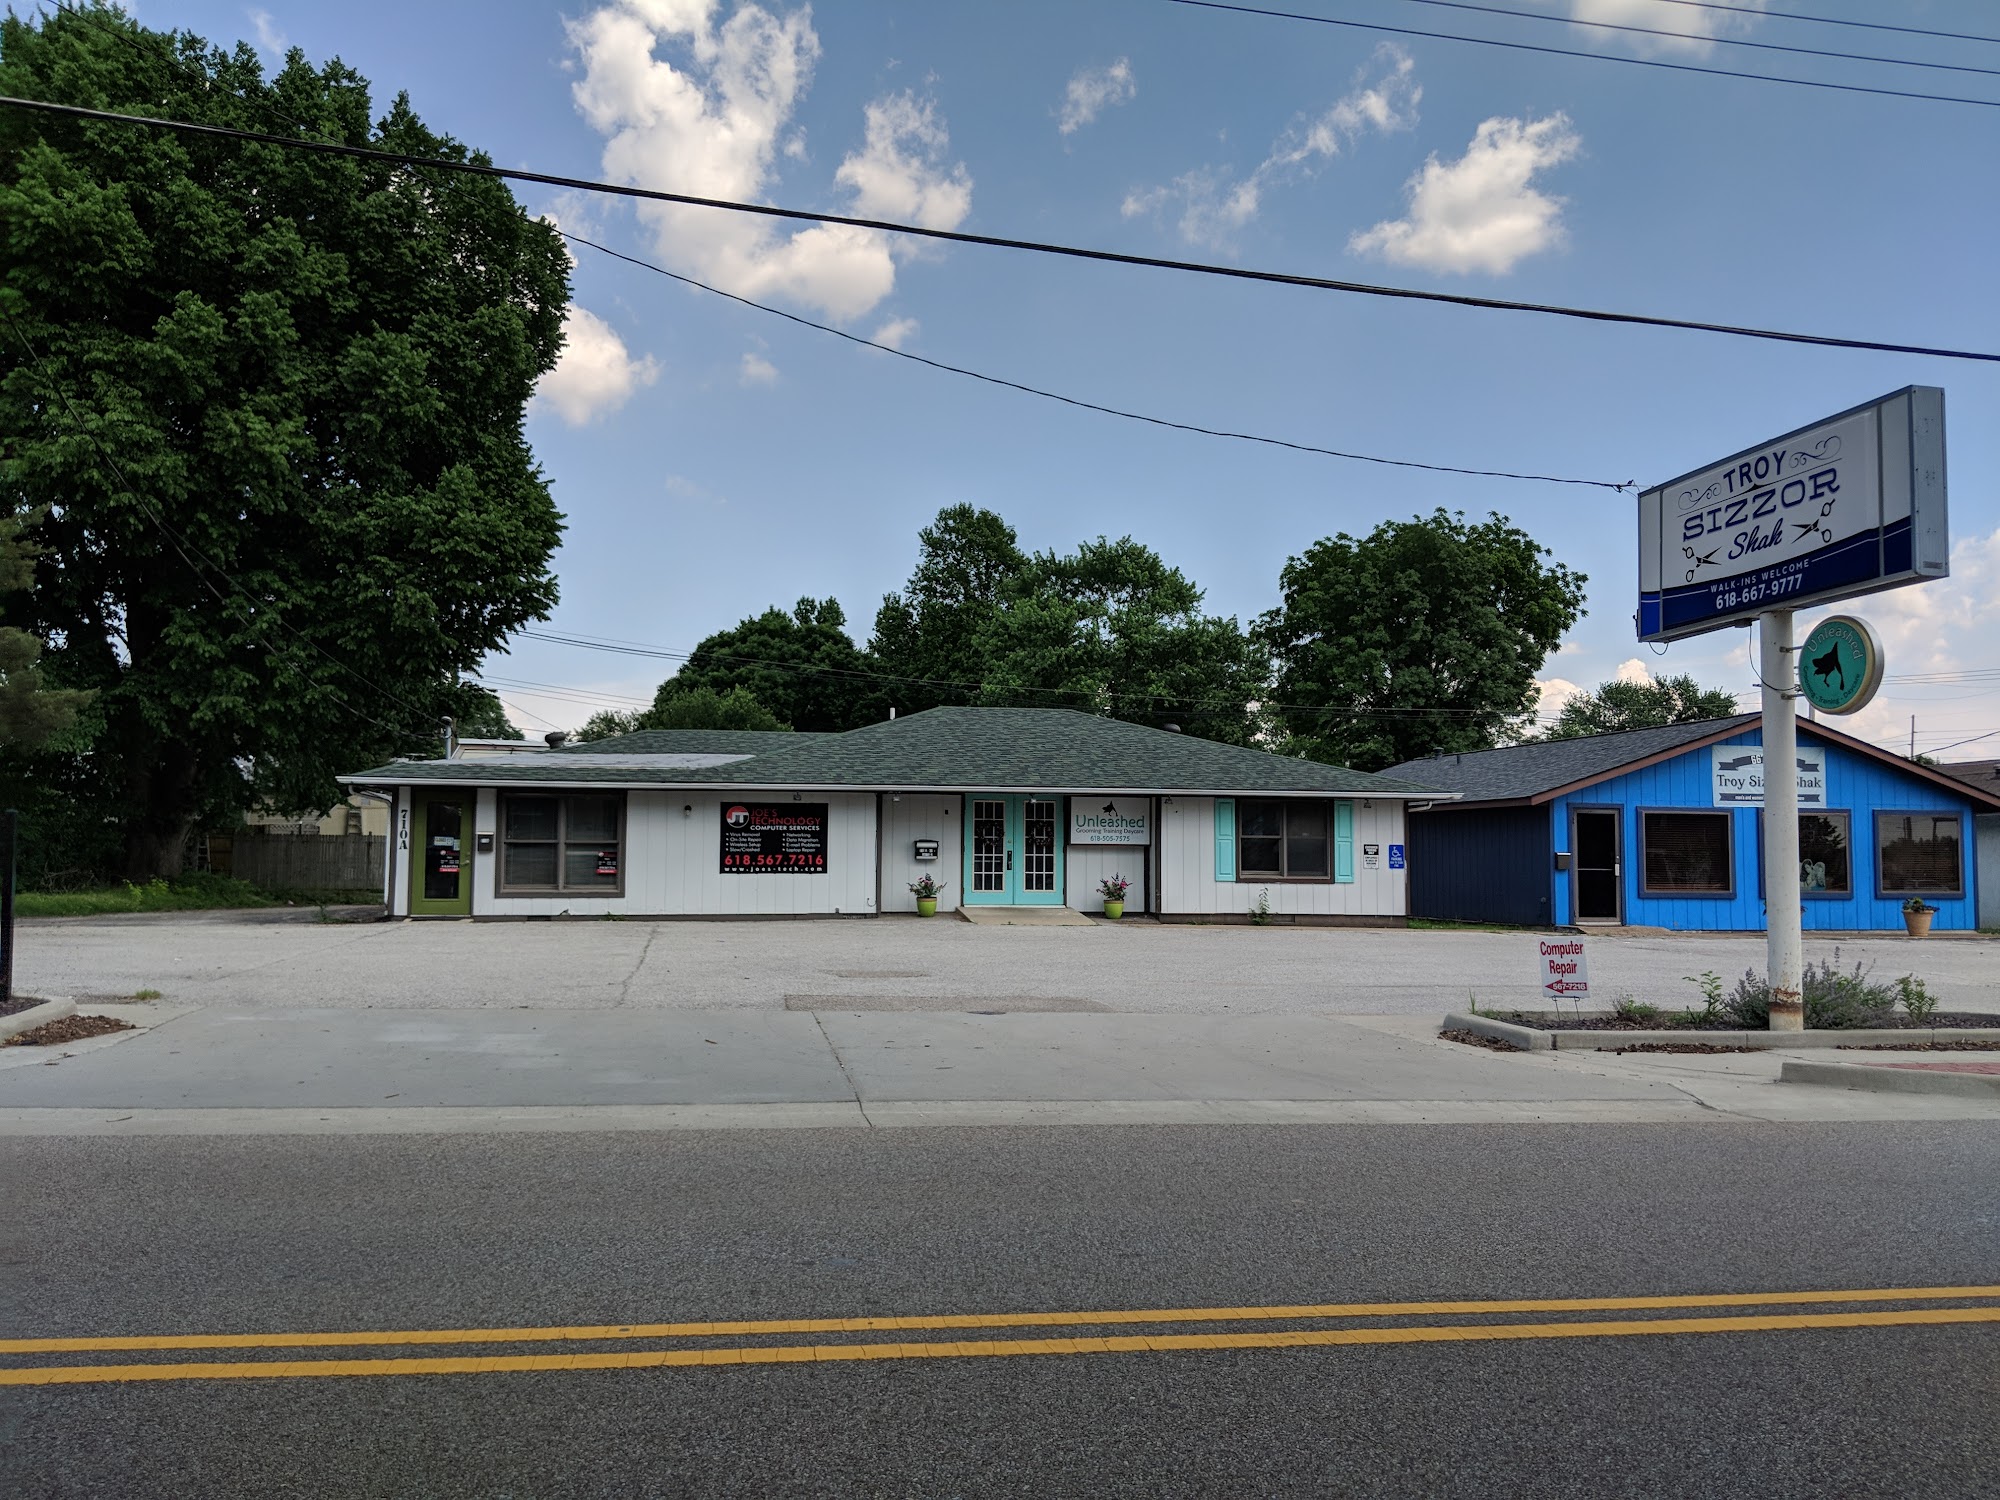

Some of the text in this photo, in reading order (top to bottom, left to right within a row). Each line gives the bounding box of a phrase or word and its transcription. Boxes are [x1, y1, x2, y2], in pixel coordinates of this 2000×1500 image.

[1723, 450, 1787, 494] TROY
[1681, 467, 1841, 543] SIZZOR
[1727, 518, 1784, 560] Shak
[1710, 559, 1810, 593] WALK-INS WELCOME
[1715, 573, 1803, 610] 618-667-9777
[1807, 627, 1864, 660] Unleashed
[1716, 774, 1746, 790] Troy
[750, 808, 778, 817] JOE'S
[751, 817, 821, 825] TECHNOLOGY
[1075, 814, 1145, 828] Unleashed
[399, 809, 408, 849] 710A
[724, 854, 824, 865] 618.567.7216
[1539, 940, 1584, 959] Computer
[1548, 959, 1578, 977] Repair
